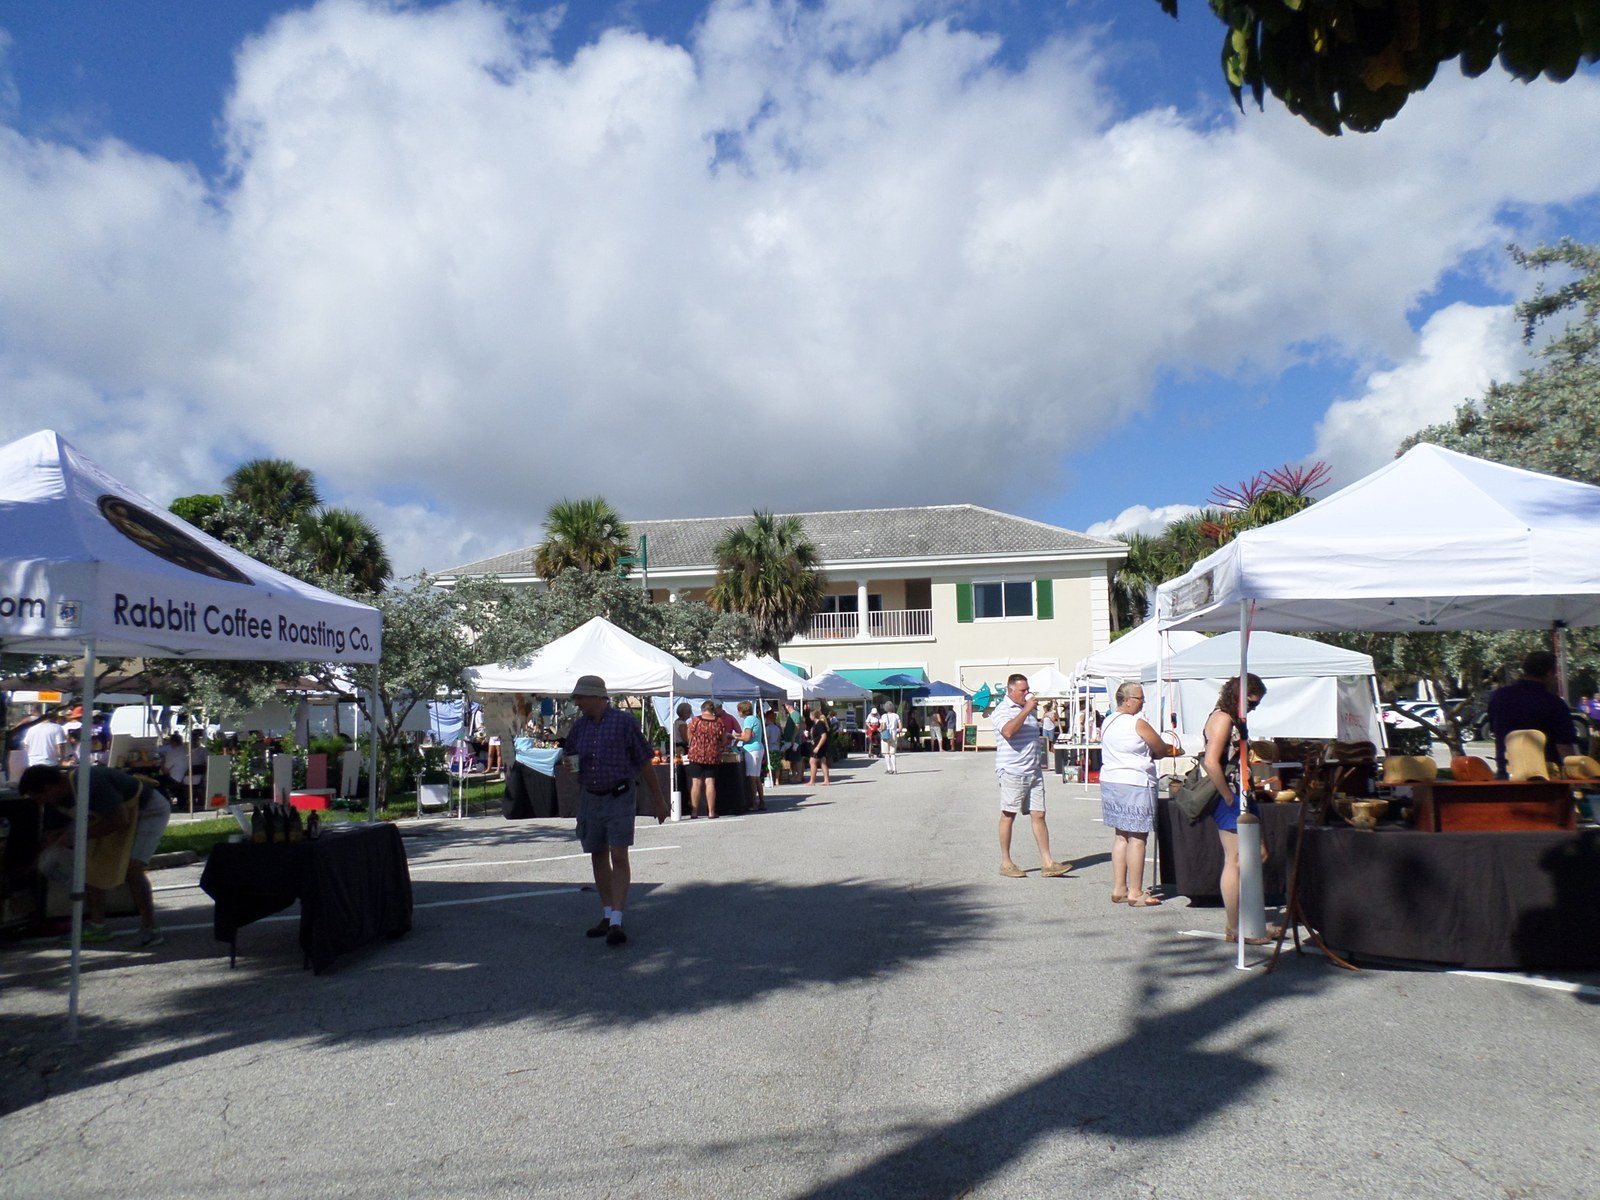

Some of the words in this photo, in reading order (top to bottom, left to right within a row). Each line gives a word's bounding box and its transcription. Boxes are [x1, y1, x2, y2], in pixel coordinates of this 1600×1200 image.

[114, 592, 197, 632] Rabbit
[203, 605, 273, 640] Coffee
[278, 614, 346, 654] Roasting
[349, 626, 373, 651] Co.
